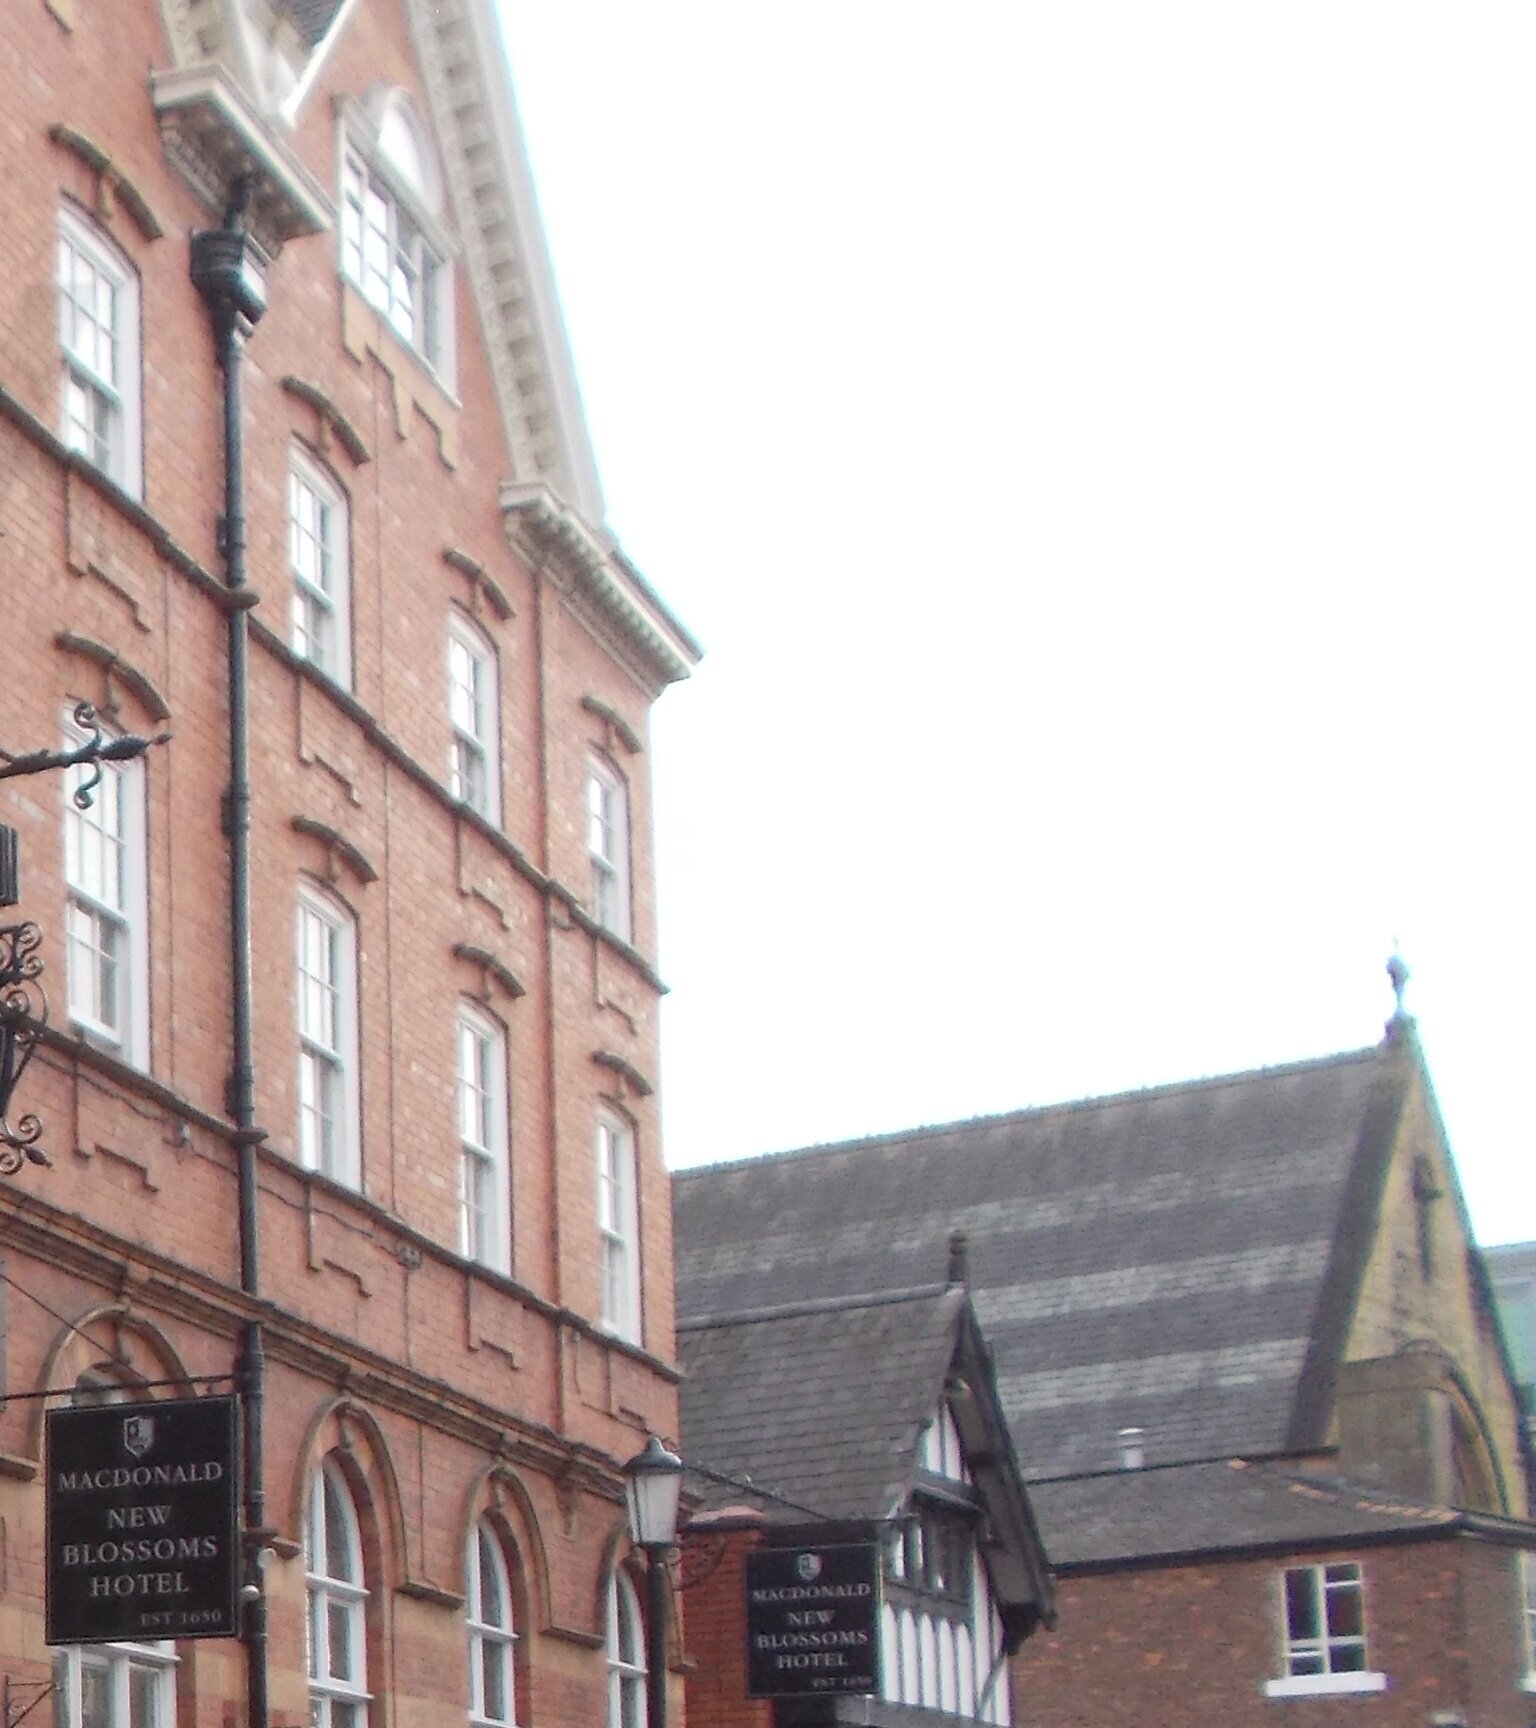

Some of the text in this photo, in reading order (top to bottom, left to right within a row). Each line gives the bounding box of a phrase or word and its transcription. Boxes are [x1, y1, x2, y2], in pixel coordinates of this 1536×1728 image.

[57, 1461, 223, 1491] MACDONALD
[107, 1505, 172, 1529] NEW
[63, 1535, 218, 1565] BLOSSOMS
[91, 1572, 190, 1596] HOTEL
[752, 1583, 871, 1601] MACDONALD
[141, 1608, 222, 1626] EST 1650
[787, 1610, 835, 1625] NEW
[757, 1630, 868, 1649] BLOSSOMS
[778, 1652, 848, 1668] HOTEL
